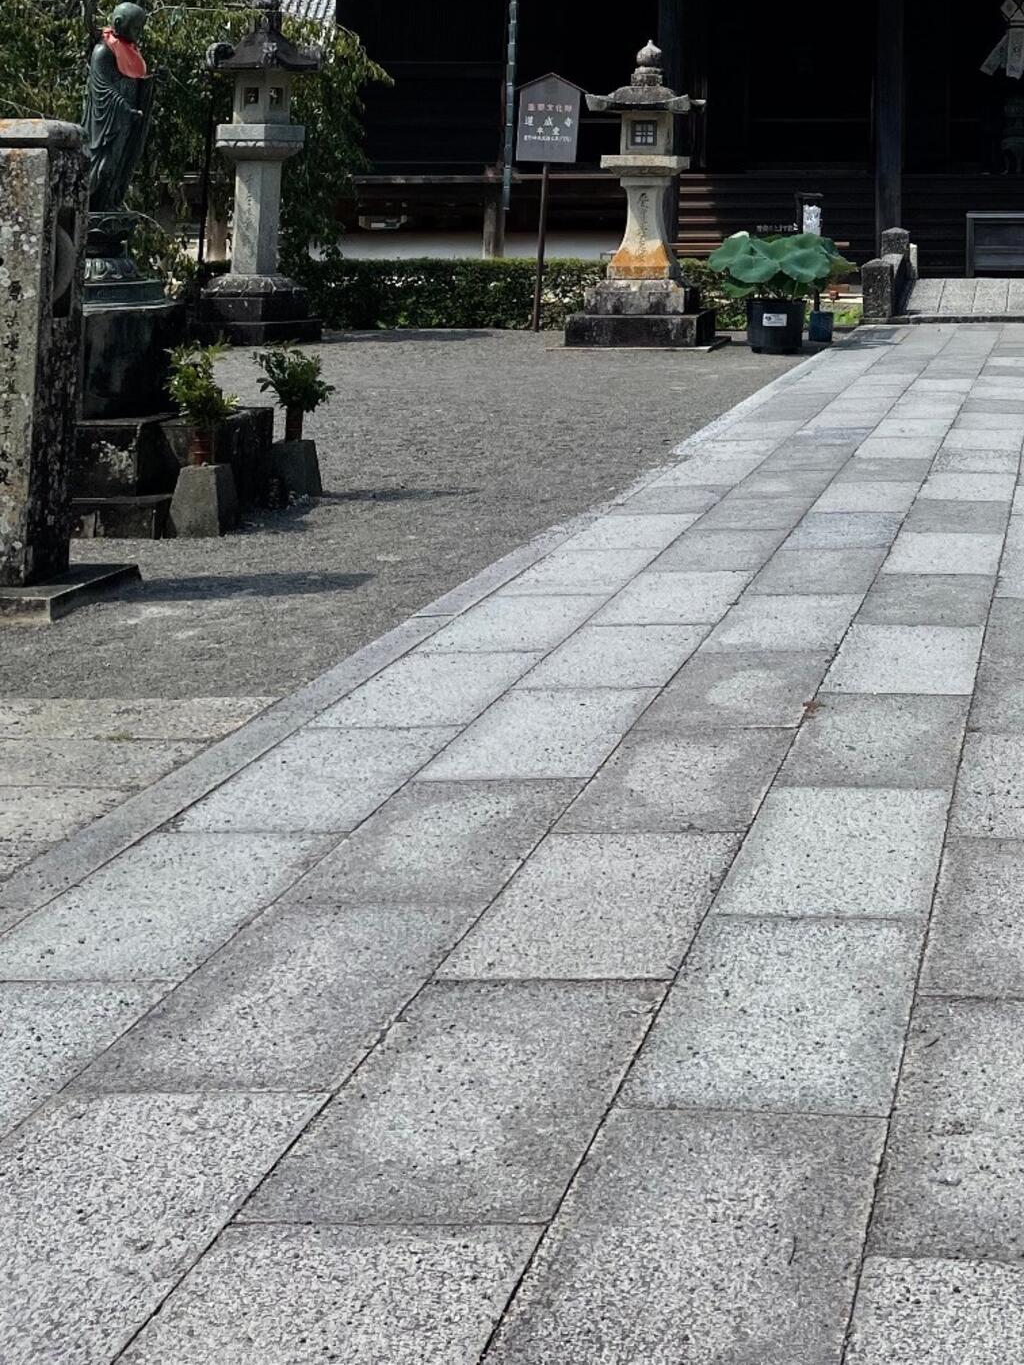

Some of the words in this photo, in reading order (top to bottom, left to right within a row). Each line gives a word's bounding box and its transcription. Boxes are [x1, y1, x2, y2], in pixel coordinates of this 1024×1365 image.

[523, 115, 573, 128] 道成寺
[536, 126, 560, 136] 本堂
